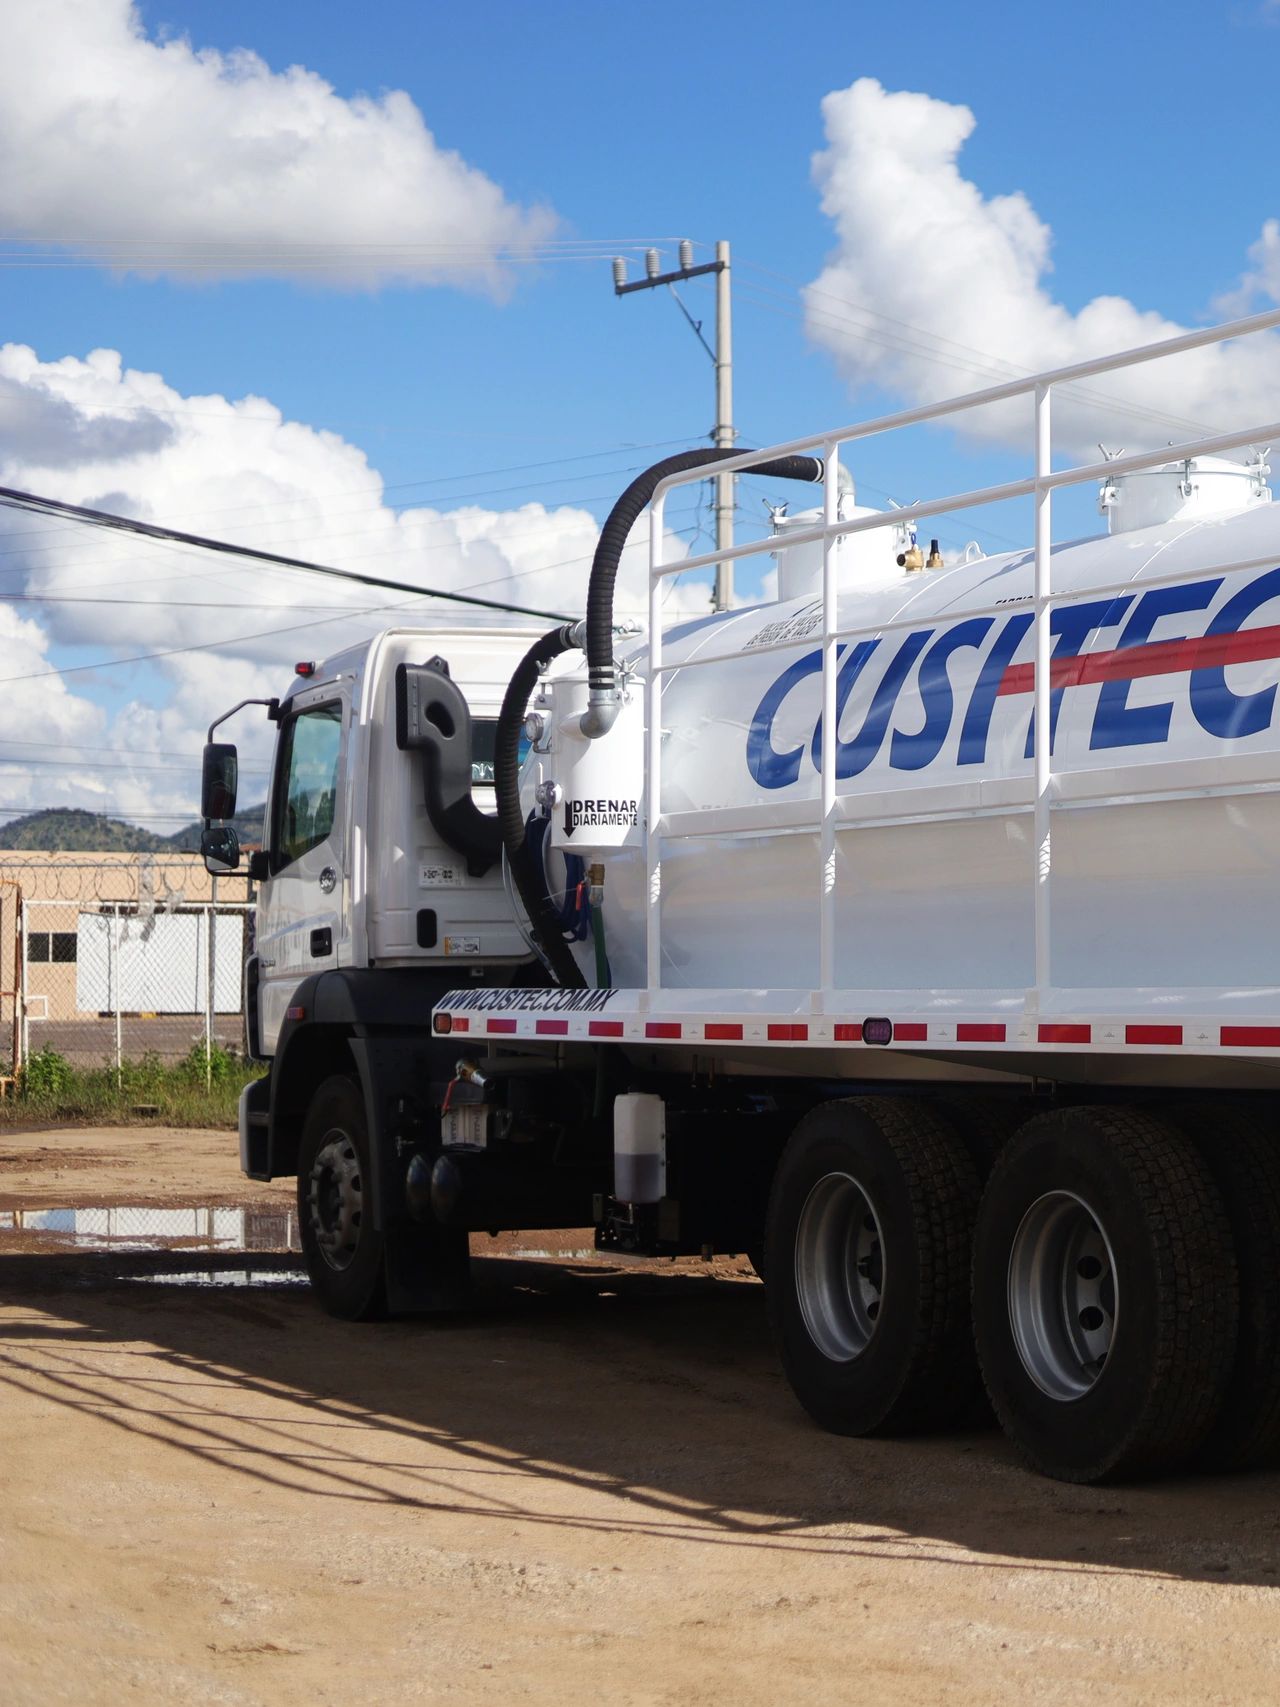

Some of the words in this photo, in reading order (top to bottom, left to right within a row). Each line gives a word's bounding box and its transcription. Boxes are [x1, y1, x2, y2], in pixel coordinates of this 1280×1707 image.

[573, 799, 637, 813] DRENAR
[573, 813, 638, 826] DIARIAMENTE
[436, 989, 619, 1012] WWW.CUSITEC.COM.MX
